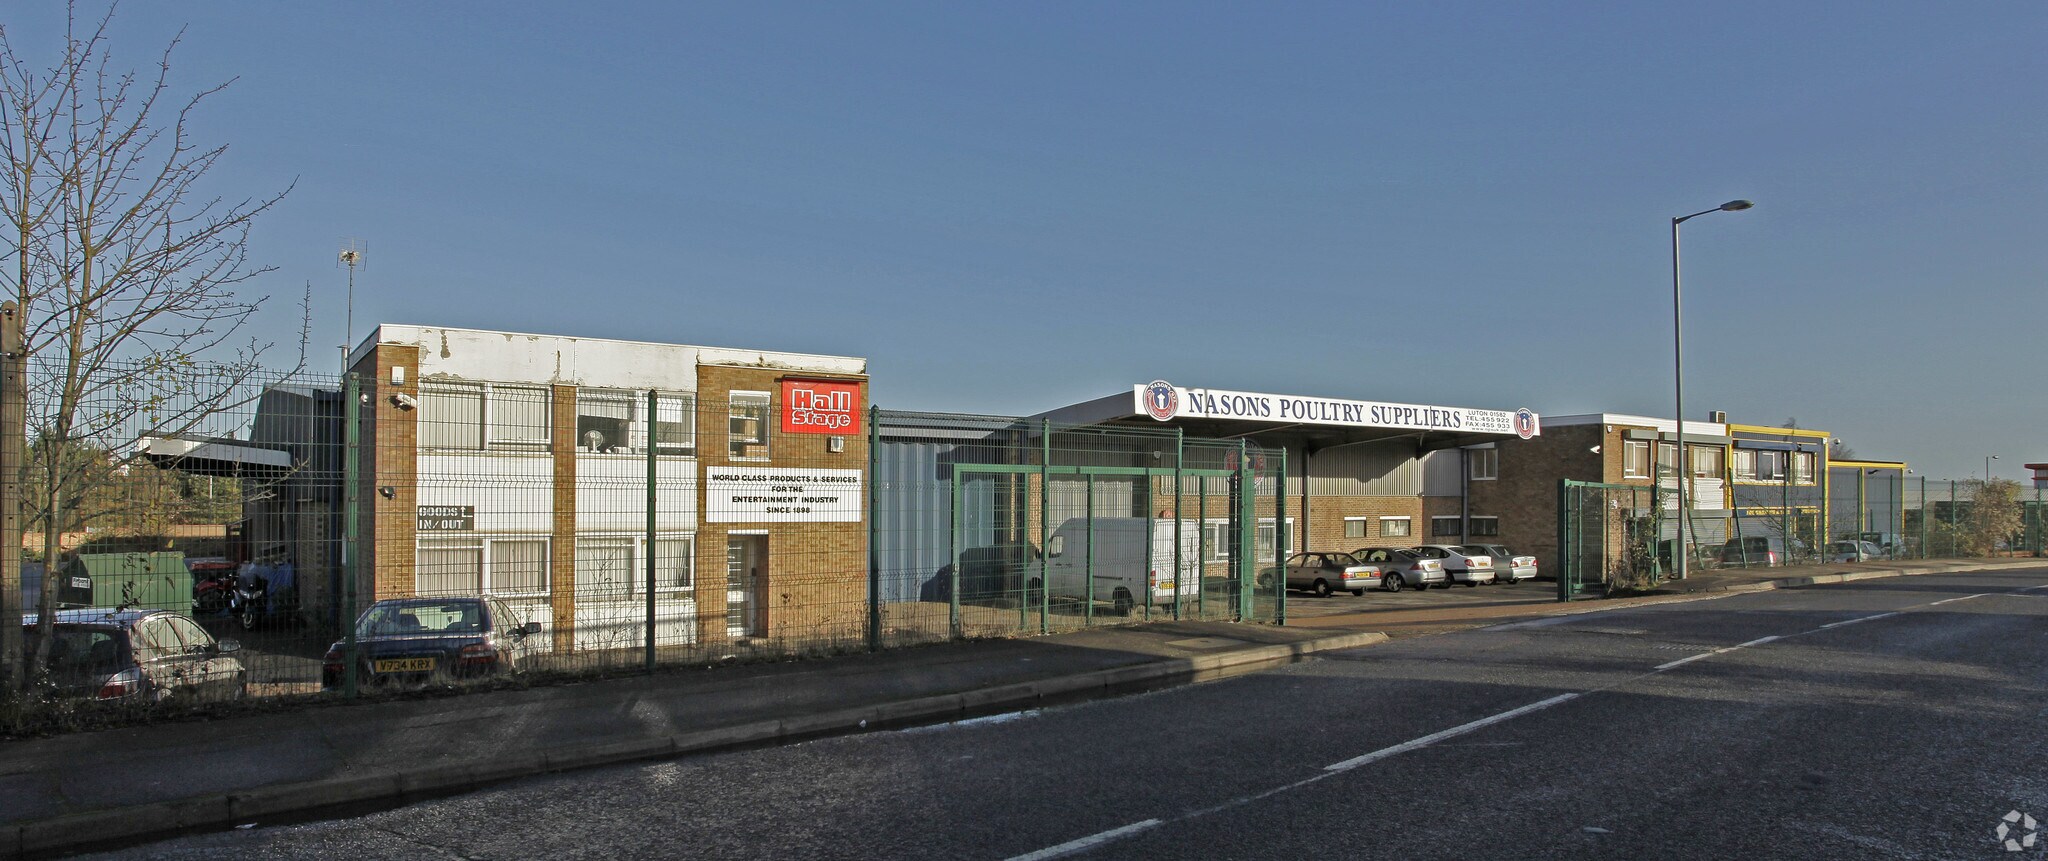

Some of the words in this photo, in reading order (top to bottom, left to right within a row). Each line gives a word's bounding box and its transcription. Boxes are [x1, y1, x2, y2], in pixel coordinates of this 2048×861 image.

[792, 388, 851, 412] Hall
[1188, 392, 1271, 418] NASONS
[1279, 398, 1364, 423] POULTRY
[1371, 405, 1461, 429] SUPPLIERS
[792, 409, 851, 429] Stage
[712, 474, 739, 482] WORLD
[741, 474, 767, 482] CLASS
[770, 475, 811, 483] PRODUCTS
[813, 475, 818, 483] &
[821, 476, 857, 484] SERVICES
[732, 496, 798, 504] ENTERTAINMENT
[801, 496, 839, 504] INDUSTRY
[418, 506, 458, 517] GOODS
[766, 506, 790, 514] SINCE
[793, 506, 811, 514] 1898
